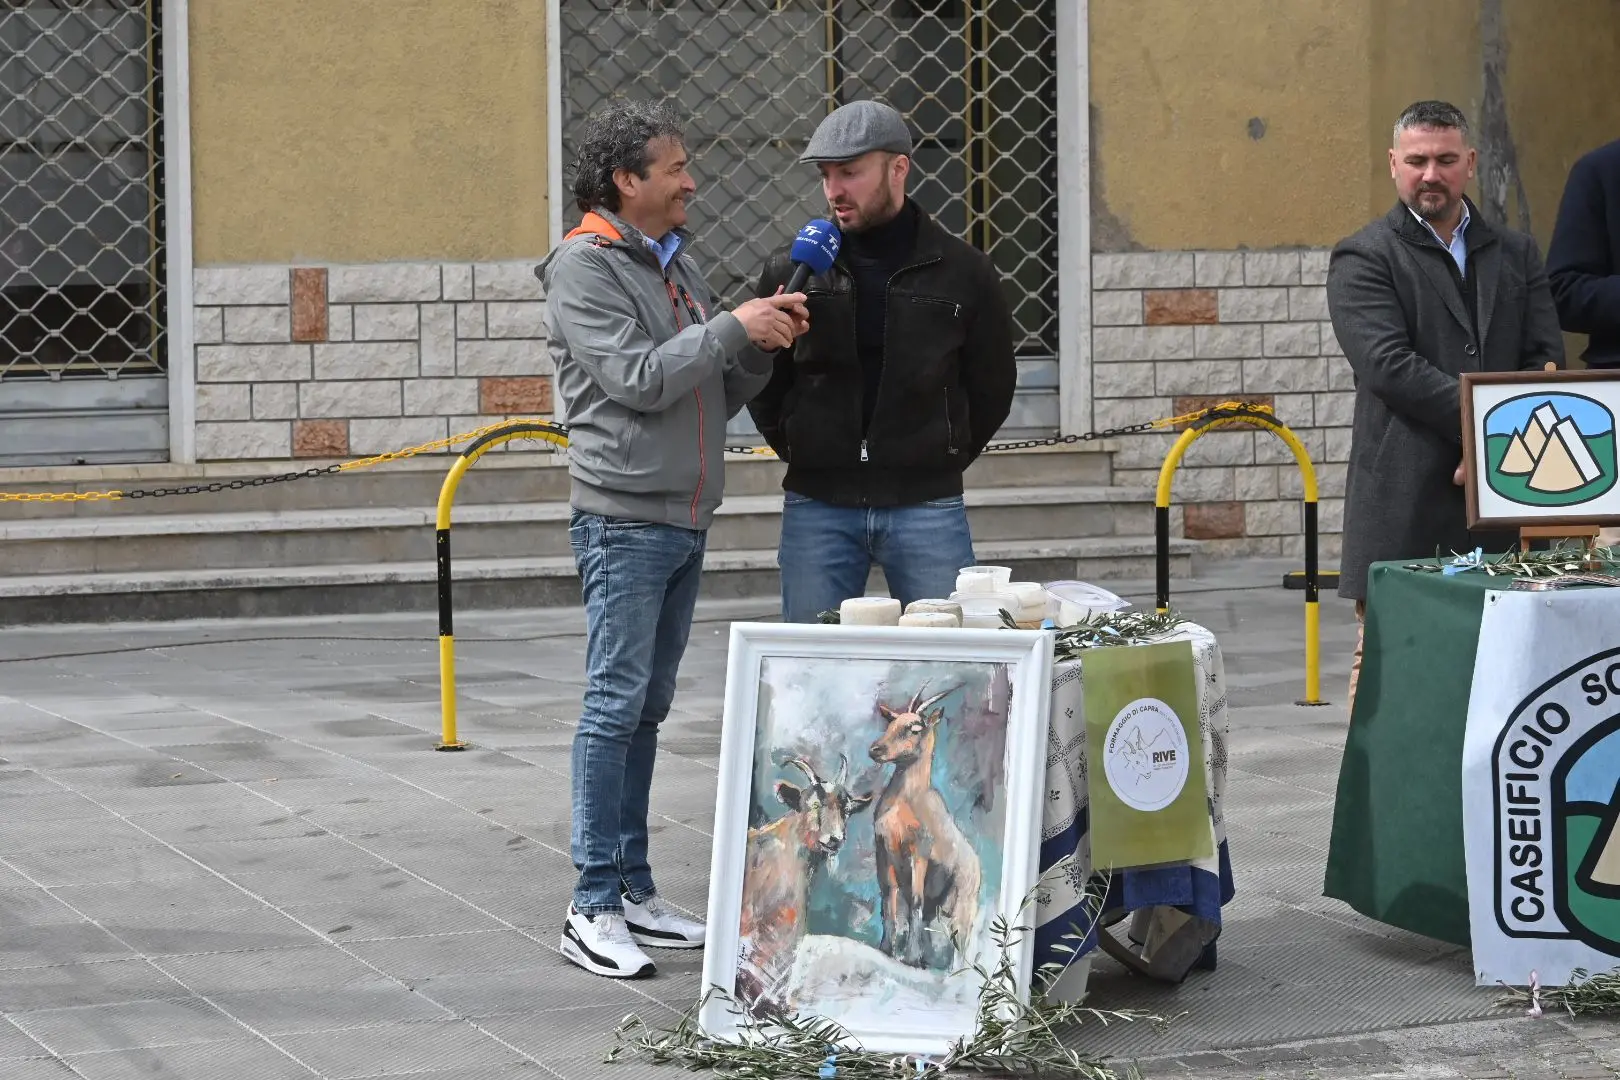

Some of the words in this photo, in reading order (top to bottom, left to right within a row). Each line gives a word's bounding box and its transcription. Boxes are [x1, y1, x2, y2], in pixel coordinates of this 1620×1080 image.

[1109, 712, 1132, 753] FORMAGGIO
[1132, 708, 1139, 716] DI
[1139, 705, 1159, 713] CAPRA
[1152, 749, 1177, 764] RIVE
[1505, 702, 1571, 923] CASEIFICIO
